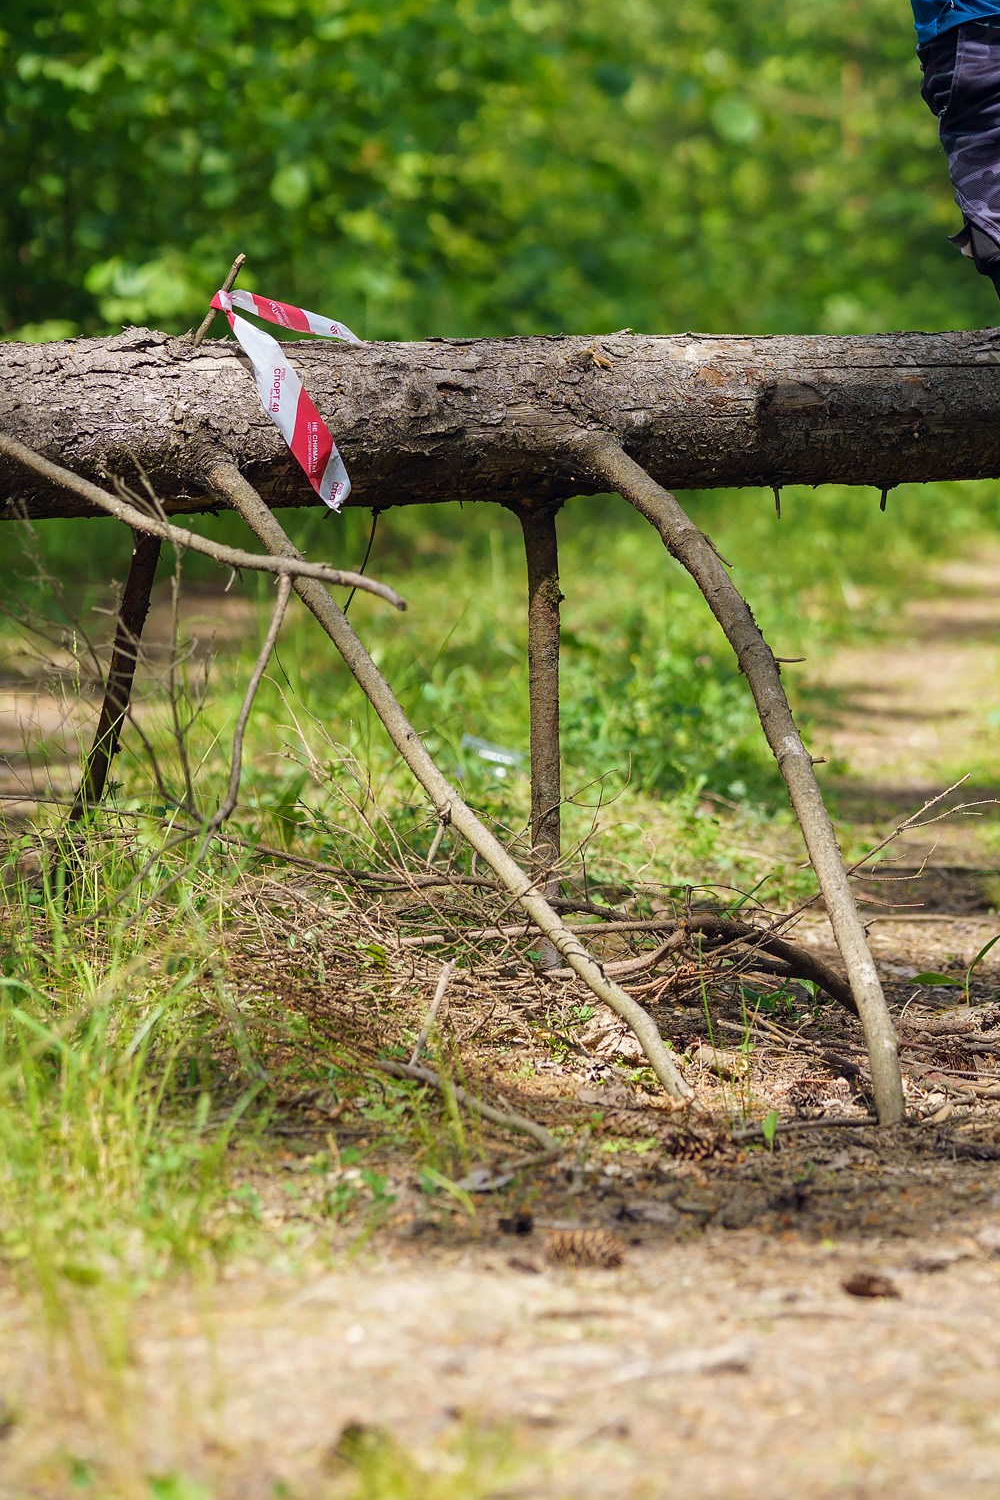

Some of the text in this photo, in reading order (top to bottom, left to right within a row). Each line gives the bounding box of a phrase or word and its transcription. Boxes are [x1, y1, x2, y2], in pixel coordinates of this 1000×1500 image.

[273, 368, 281, 400] СПОРТ
[271, 401, 280, 413] 40
[312, 421, 318, 432] НЕ
